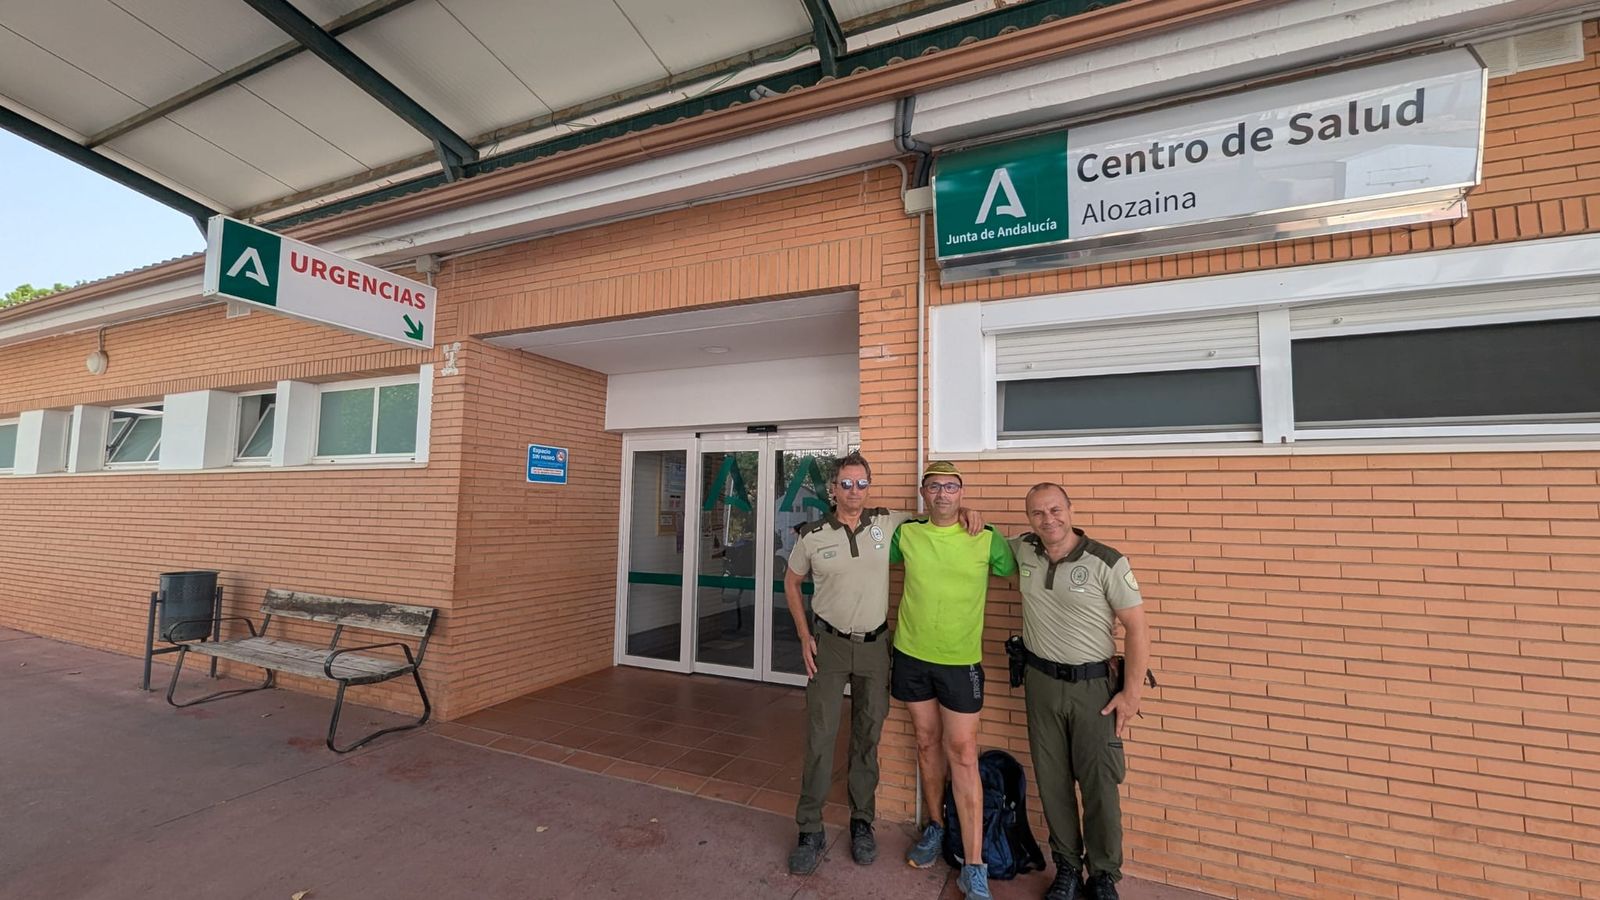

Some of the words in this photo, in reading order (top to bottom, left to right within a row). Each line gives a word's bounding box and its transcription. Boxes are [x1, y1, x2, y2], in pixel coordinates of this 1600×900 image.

[1077, 140, 1209, 182] Centro
[1221, 122, 1274, 157] de
[1288, 88, 1425, 145] Salud
[1081, 191, 1196, 225] Alozaina
[946, 233, 978, 245] Junta
[980, 229, 995, 240] de
[997, 218, 1057, 238] Andalucía
[290, 251, 426, 310] URGENCIAS
